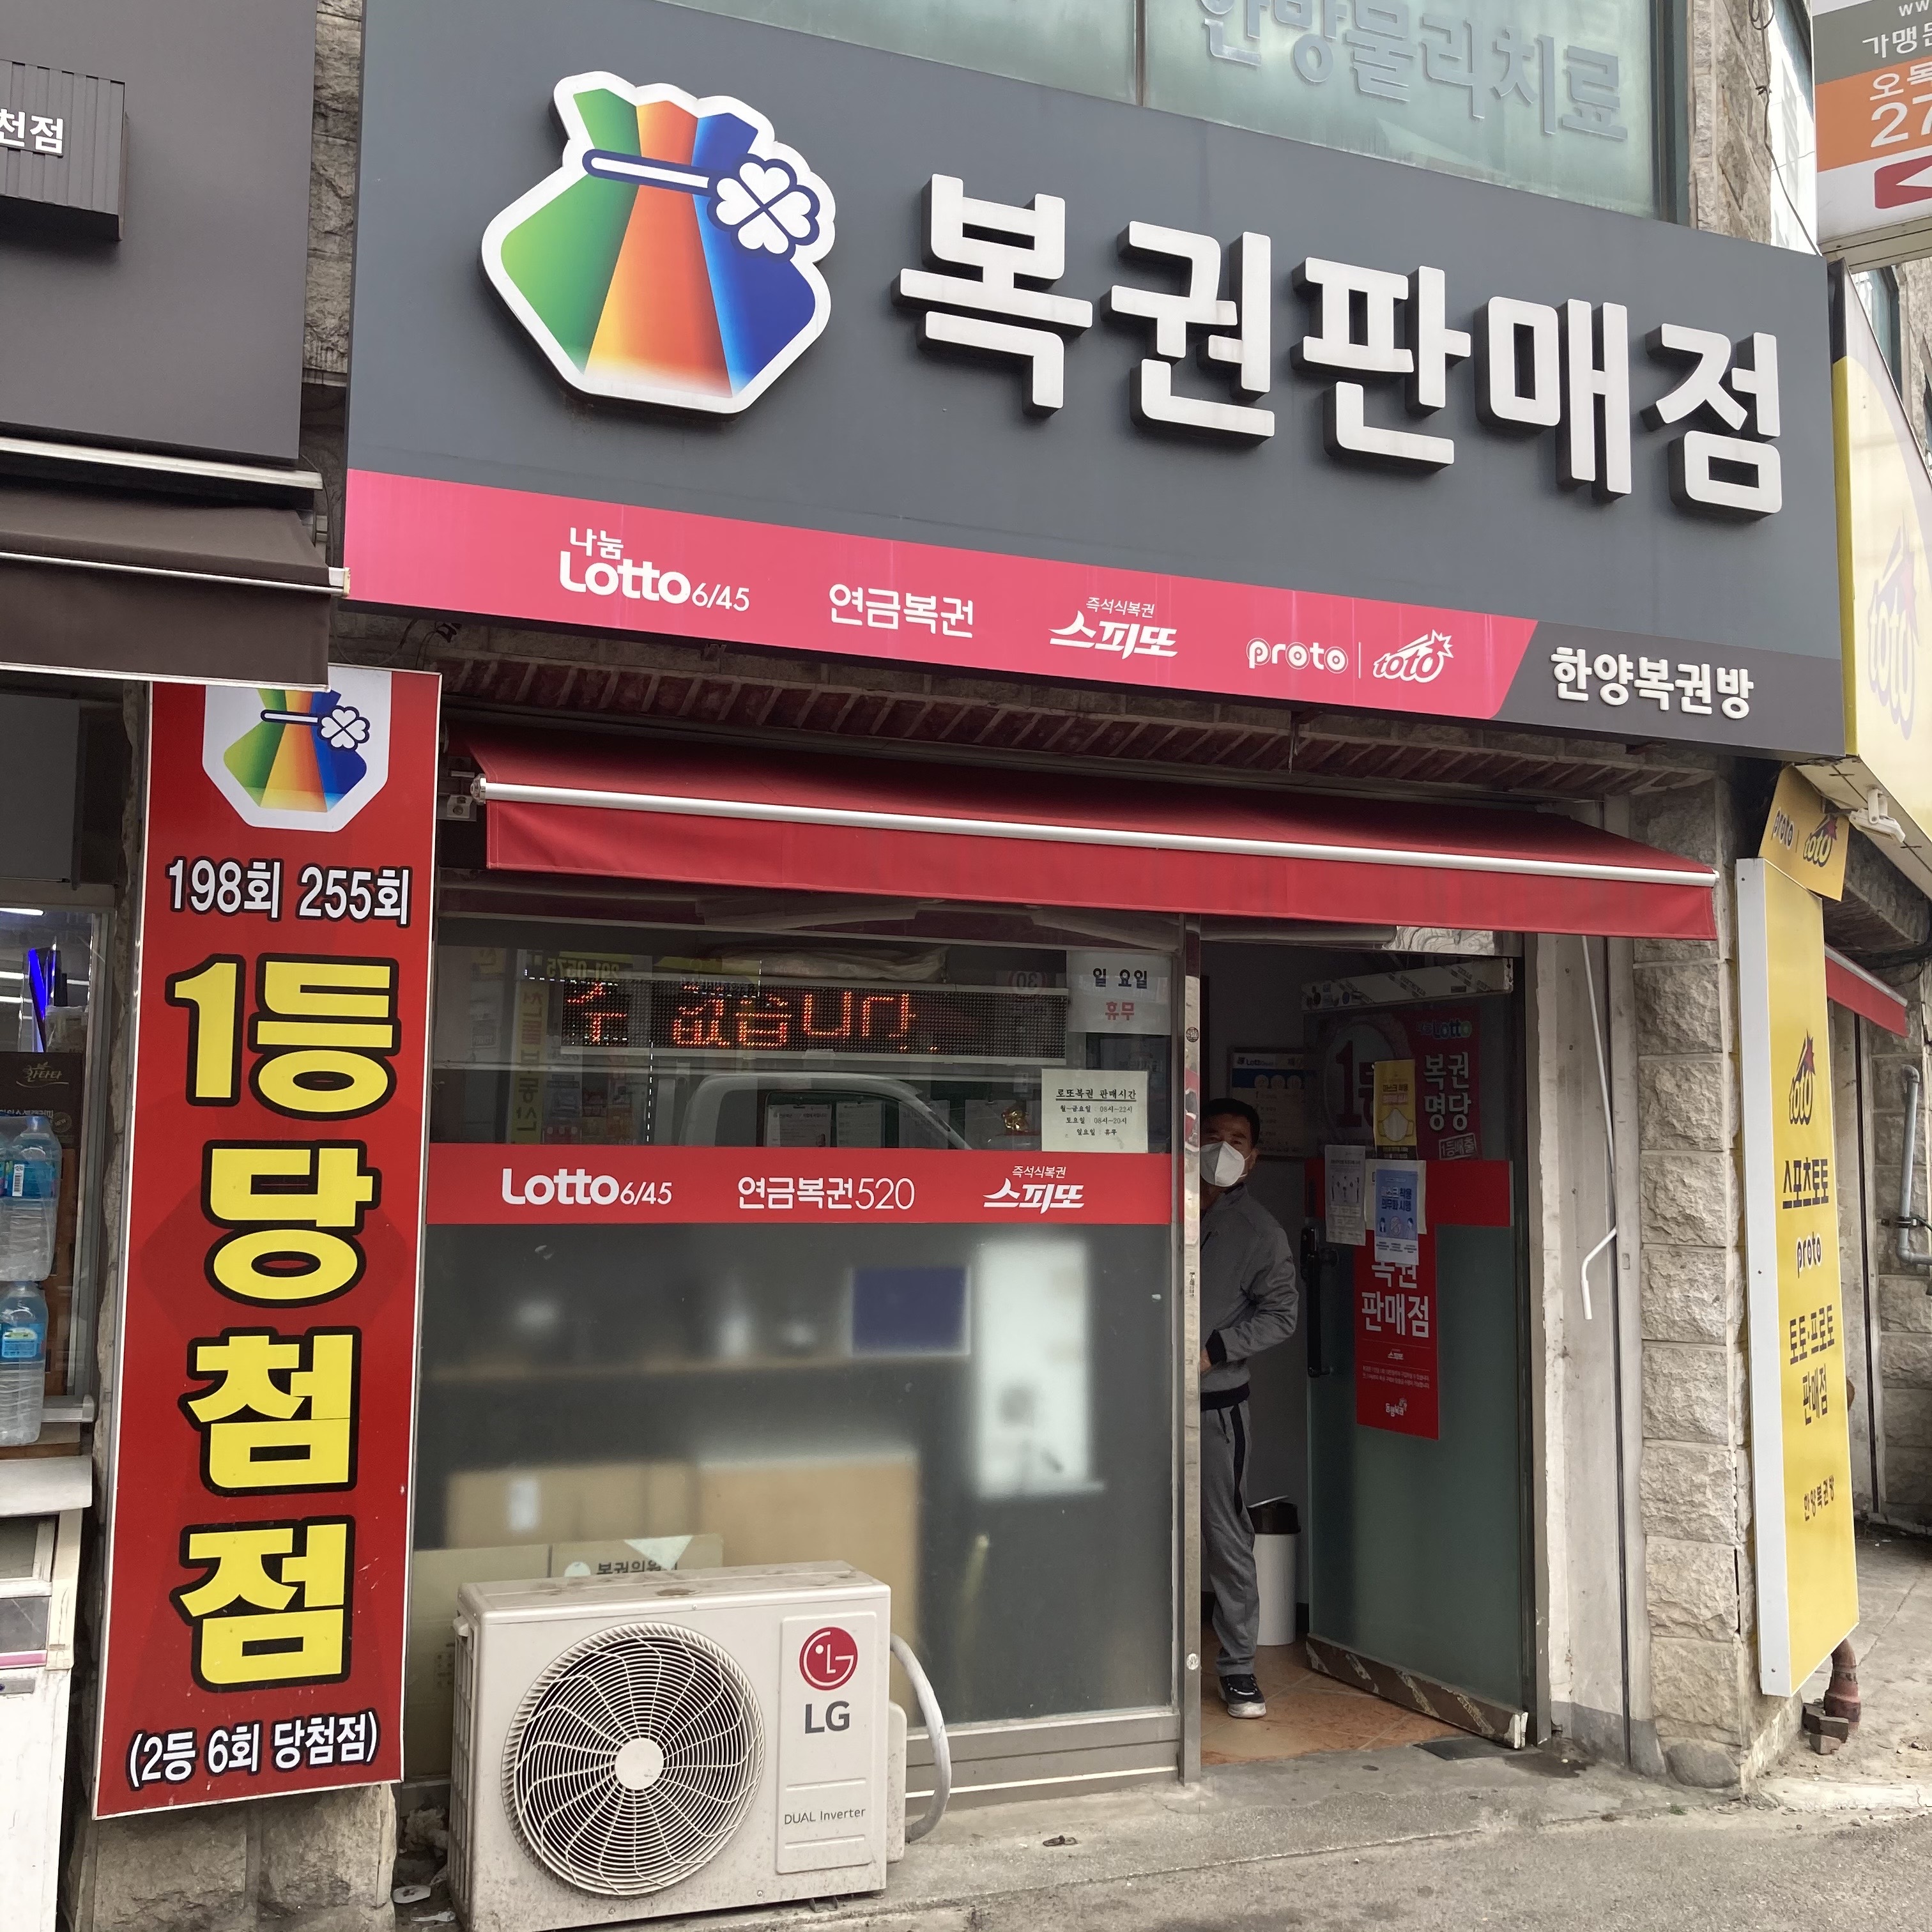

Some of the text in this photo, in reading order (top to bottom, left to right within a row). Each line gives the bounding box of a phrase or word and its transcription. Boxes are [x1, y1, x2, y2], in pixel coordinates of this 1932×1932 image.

[898, 174, 1782, 514] 복권판매점
[569, 527, 624, 560] 나눔
[829, 583, 974, 639] 연금복권
[1085, 596, 1155, 619] 즉석식복권
[1048, 610, 1179, 661] 스피또
[1246, 634, 1450, 684] proto toto
[1550, 647, 1754, 719] 한양복권방
[1803, 828, 1834, 868] toto
[168, 858, 410, 925] 198회 255회
[1105, 1001, 1135, 1021] 휴무
[1423, 1052, 1470, 1091] 복권
[1055, 1088, 1137, 1100] 로또복권 판매시간
[1424, 1092, 1472, 1131] 명당
[1011, 1165, 1067, 1179] 즉석식복권
[1782, 1156, 1829, 1210] 스포츠토토
[982, 1177, 1085, 1215] 스피또
[1796, 1231, 1821, 1279] proto
[1361, 1291, 1430, 1339] 판매점
[1802, 1363, 1828, 1425] 판매점
[804, 1700, 851, 1734] LG
[130, 1710, 378, 1788] (2등 6회 당첨점)
[783, 1807, 866, 1825] DUAL Inverter
